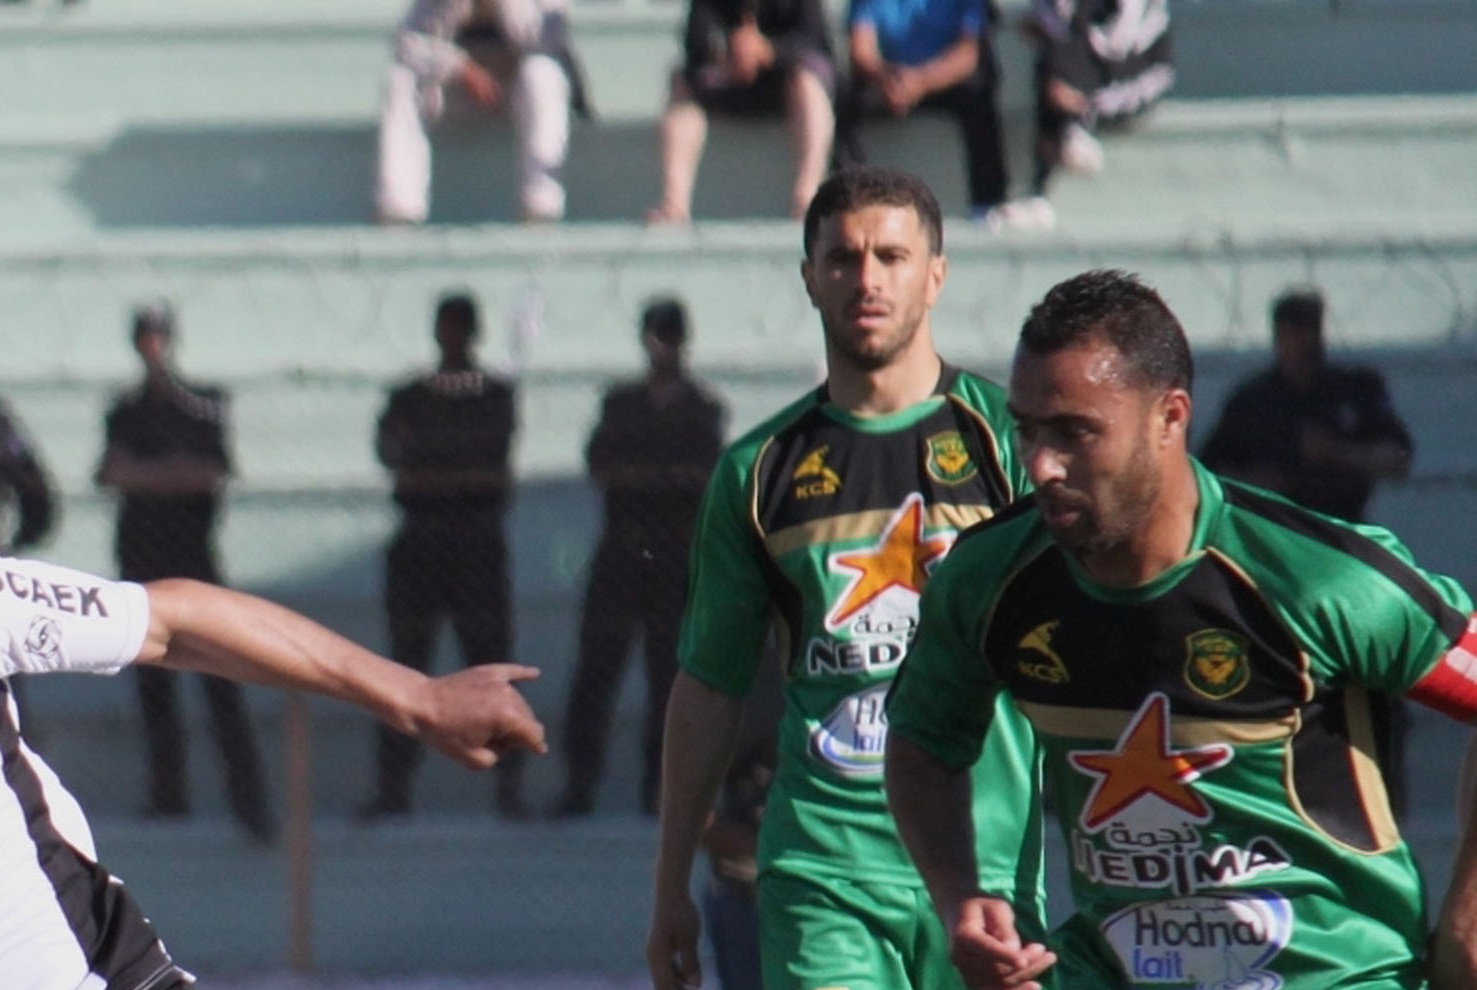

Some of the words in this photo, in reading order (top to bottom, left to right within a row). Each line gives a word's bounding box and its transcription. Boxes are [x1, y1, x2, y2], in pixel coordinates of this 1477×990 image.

[809, 640, 905, 672] NED
[1109, 821, 1198, 846] نجمة
[1133, 906, 1268, 947] Hodna
[1134, 948, 1184, 979] lait
